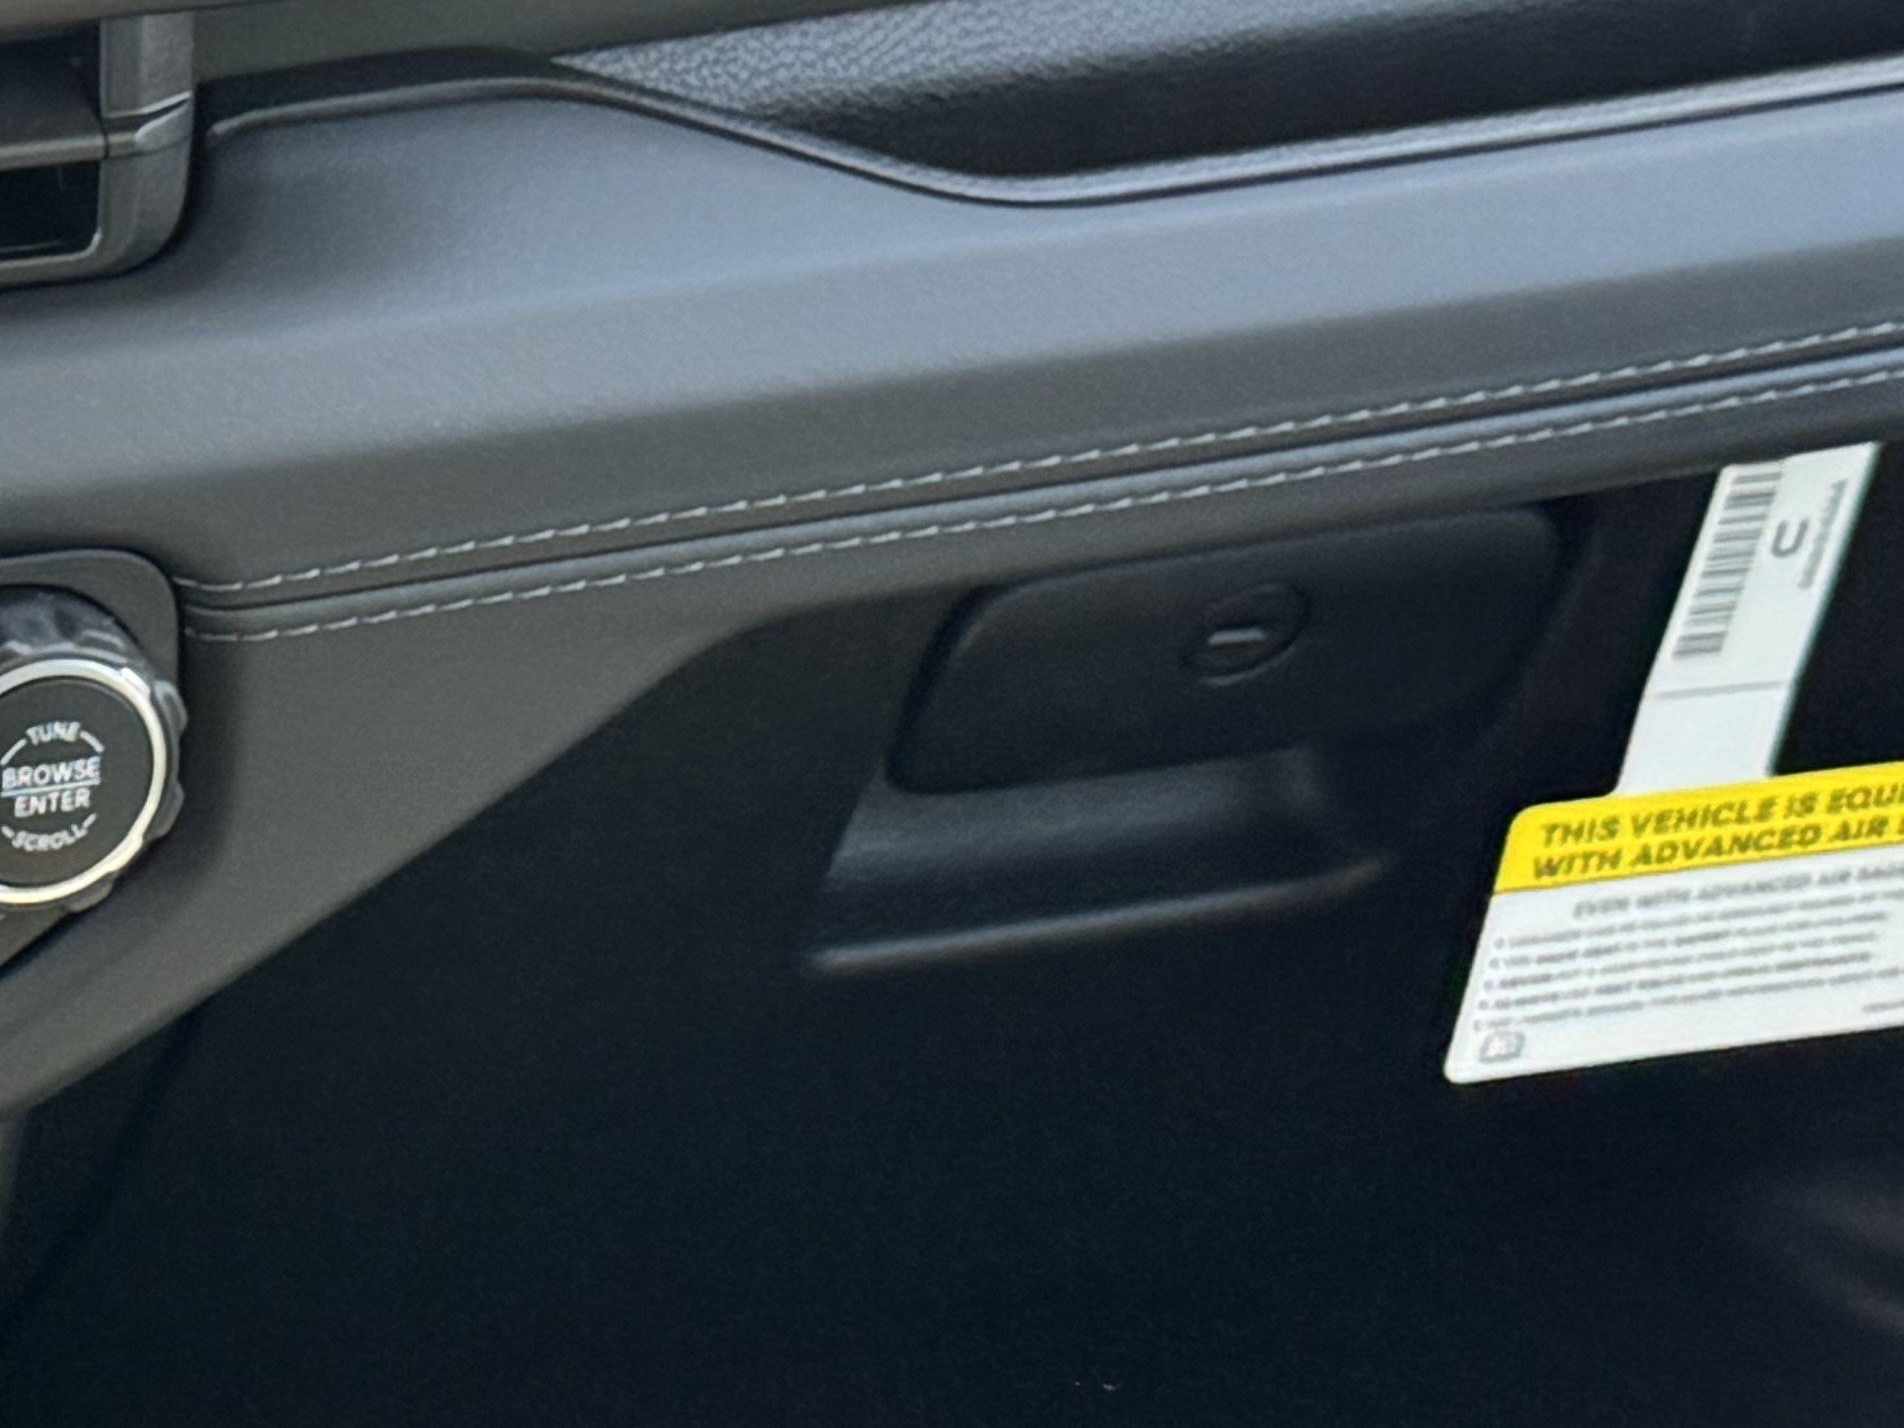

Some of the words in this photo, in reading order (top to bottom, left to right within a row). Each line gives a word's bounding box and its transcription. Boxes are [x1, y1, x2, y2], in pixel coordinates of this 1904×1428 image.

[26, 721, 80, 746] TUNE
[2, 755, 101, 789] BROWSE
[14, 788, 91, 817] ENTER
[1543, 815, 1620, 847] THIS
[1631, 796, 1778, 835] VEHICLE
[1783, 790, 1817, 819] IS
[1533, 848, 1623, 879] WITH
[1631, 822, 1822, 866] ADVANCED
[1828, 816, 1889, 842] AIR
